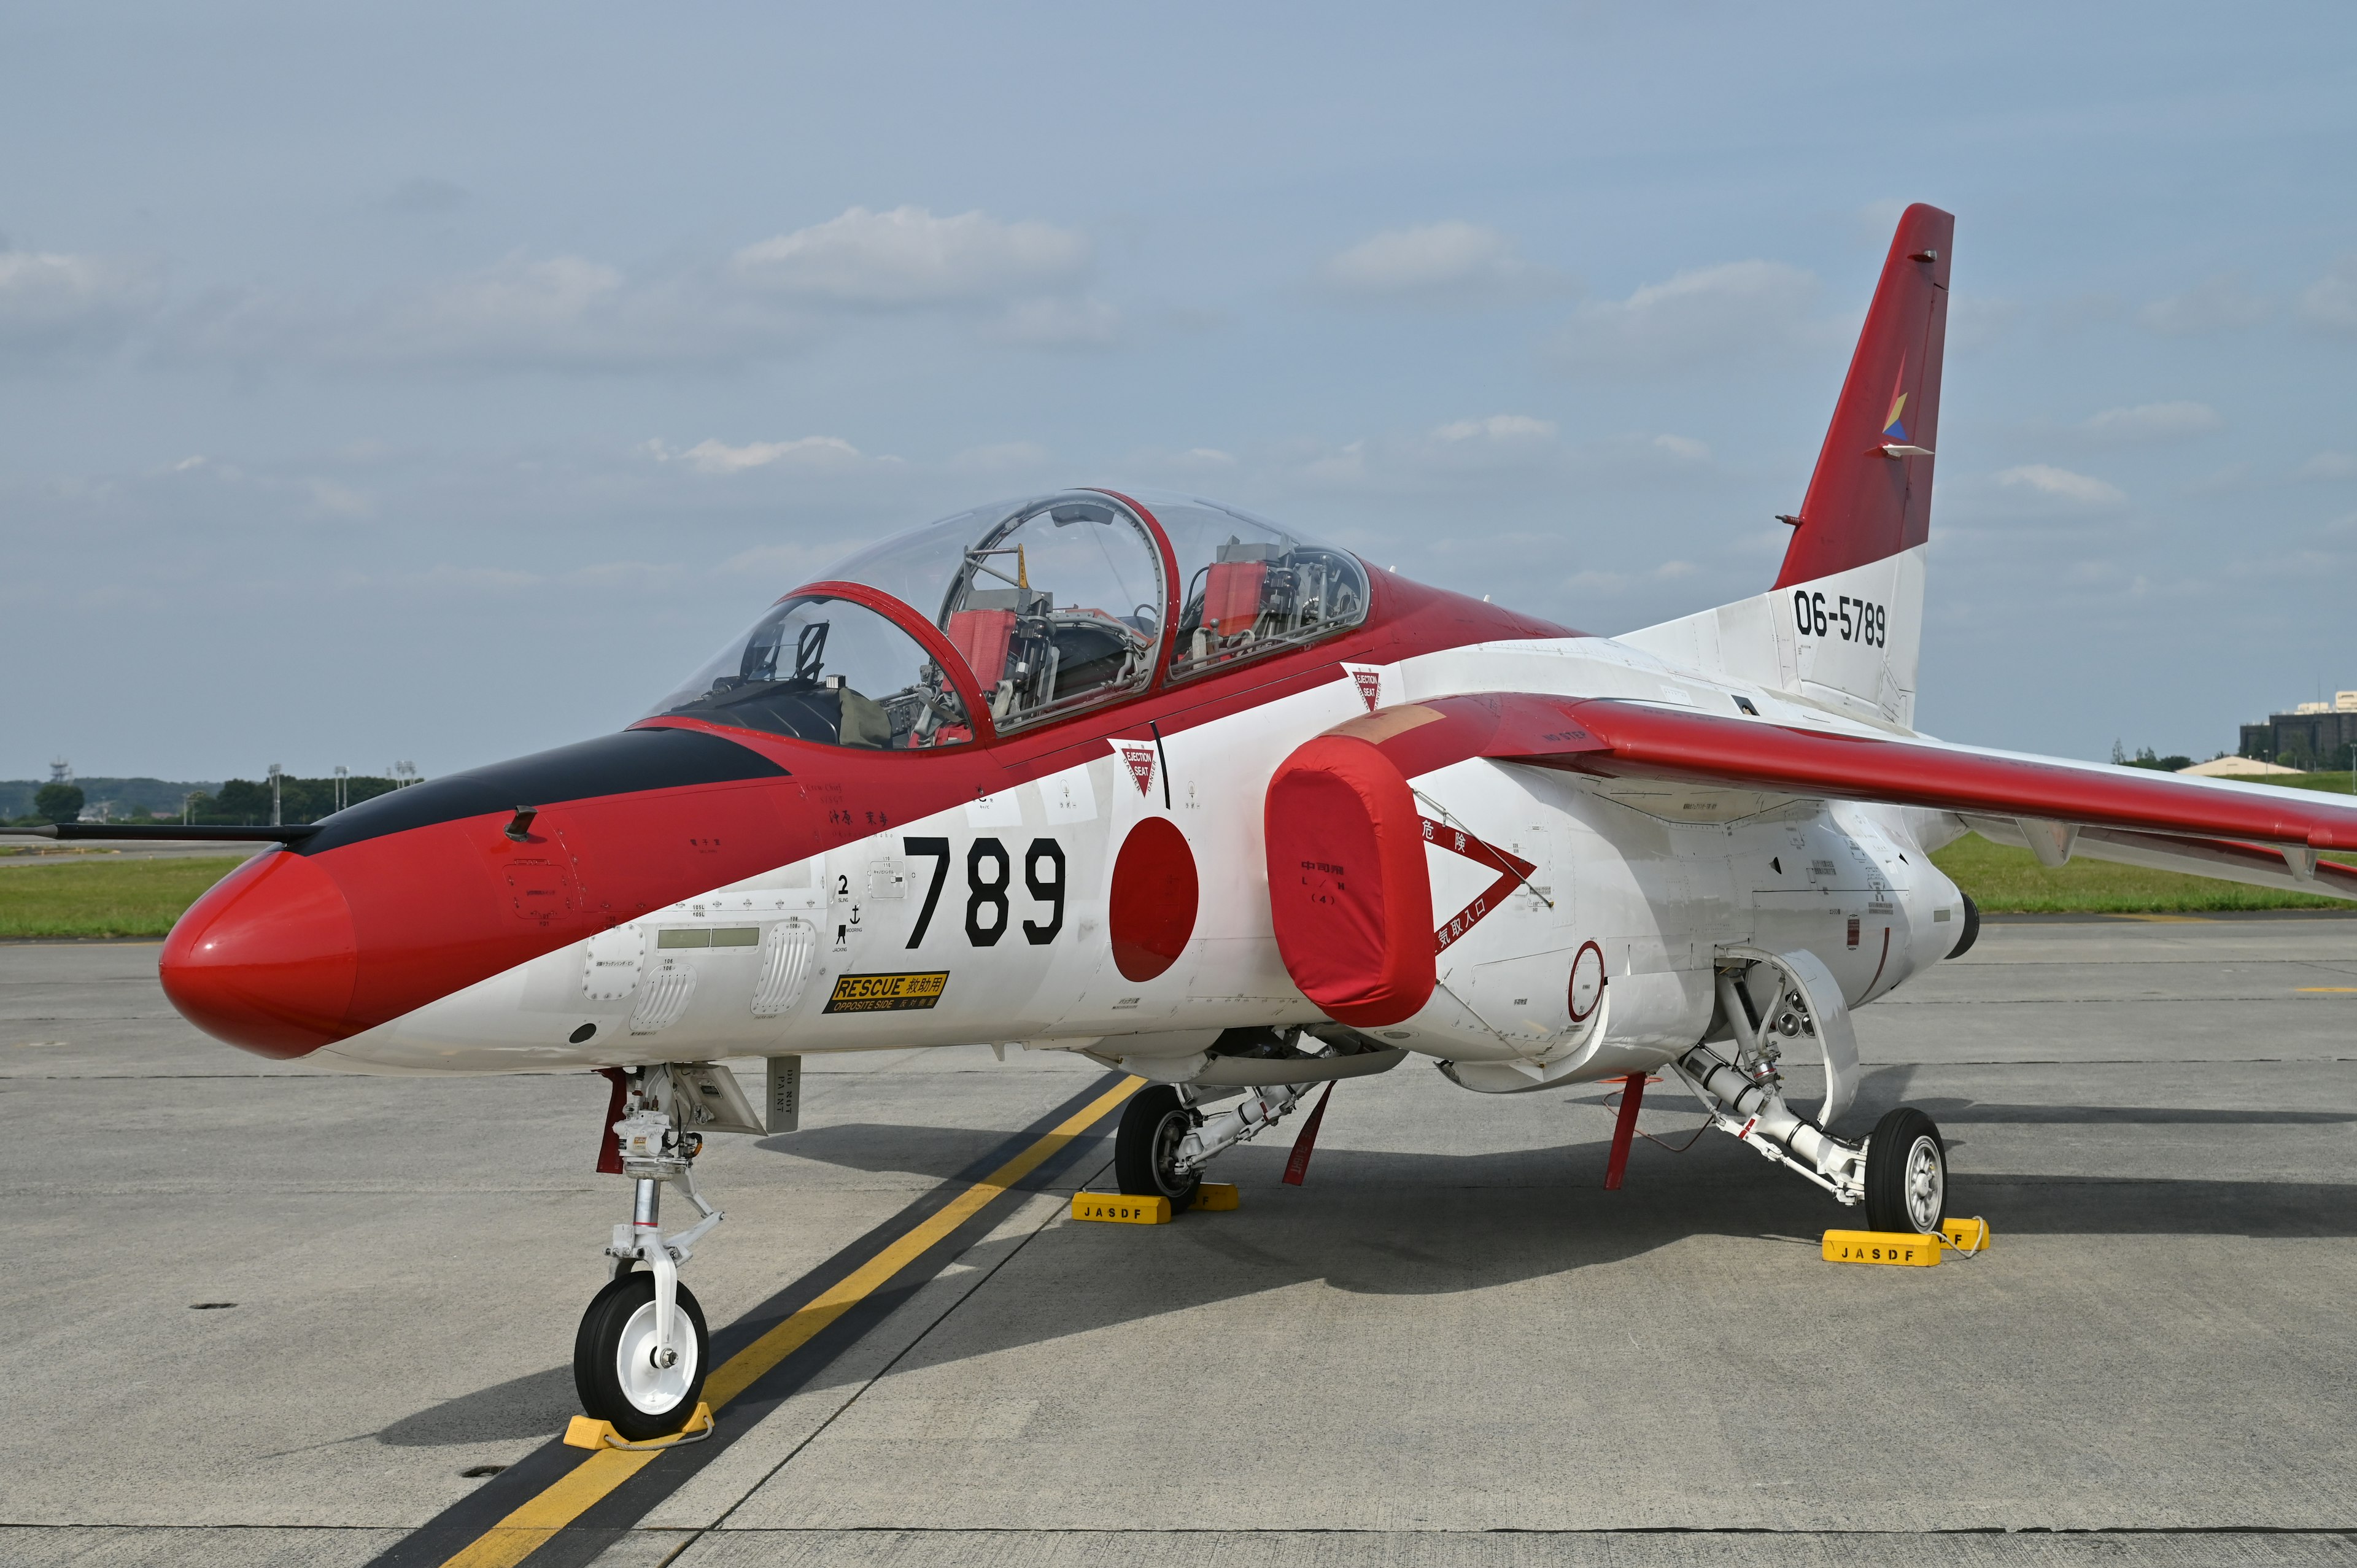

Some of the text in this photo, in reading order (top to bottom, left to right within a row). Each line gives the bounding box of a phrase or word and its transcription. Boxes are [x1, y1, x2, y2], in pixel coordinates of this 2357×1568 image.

[1794, 590, 1885, 649] 06-5789
[1357, 674, 1378, 684] EJECTION
[1354, 680, 1369, 711] DANGER
[1363, 688, 1376, 697] SEAT
[1559, 731, 1586, 741] STEP
[1126, 751, 1152, 763] EJECTION
[1123, 759, 1141, 792] DANGER
[1134, 766, 1148, 776] SEAT
[1147, 760, 1157, 792] DANGER
[1422, 819, 1466, 853] 危険
[903, 836, 1066, 949] 789
[1434, 898, 1486, 953] 気取入口
[835, 977, 943, 998] RESCUE 救助用
[833, 997, 937, 1011] OPPOSITE SIDE 反対側面
[787, 1069, 793, 1084] DO
[776, 1076, 785, 1113] PAINT
[1084, 1207, 1141, 1219] JASDF
[1841, 1247, 1914, 1261] JASDF
